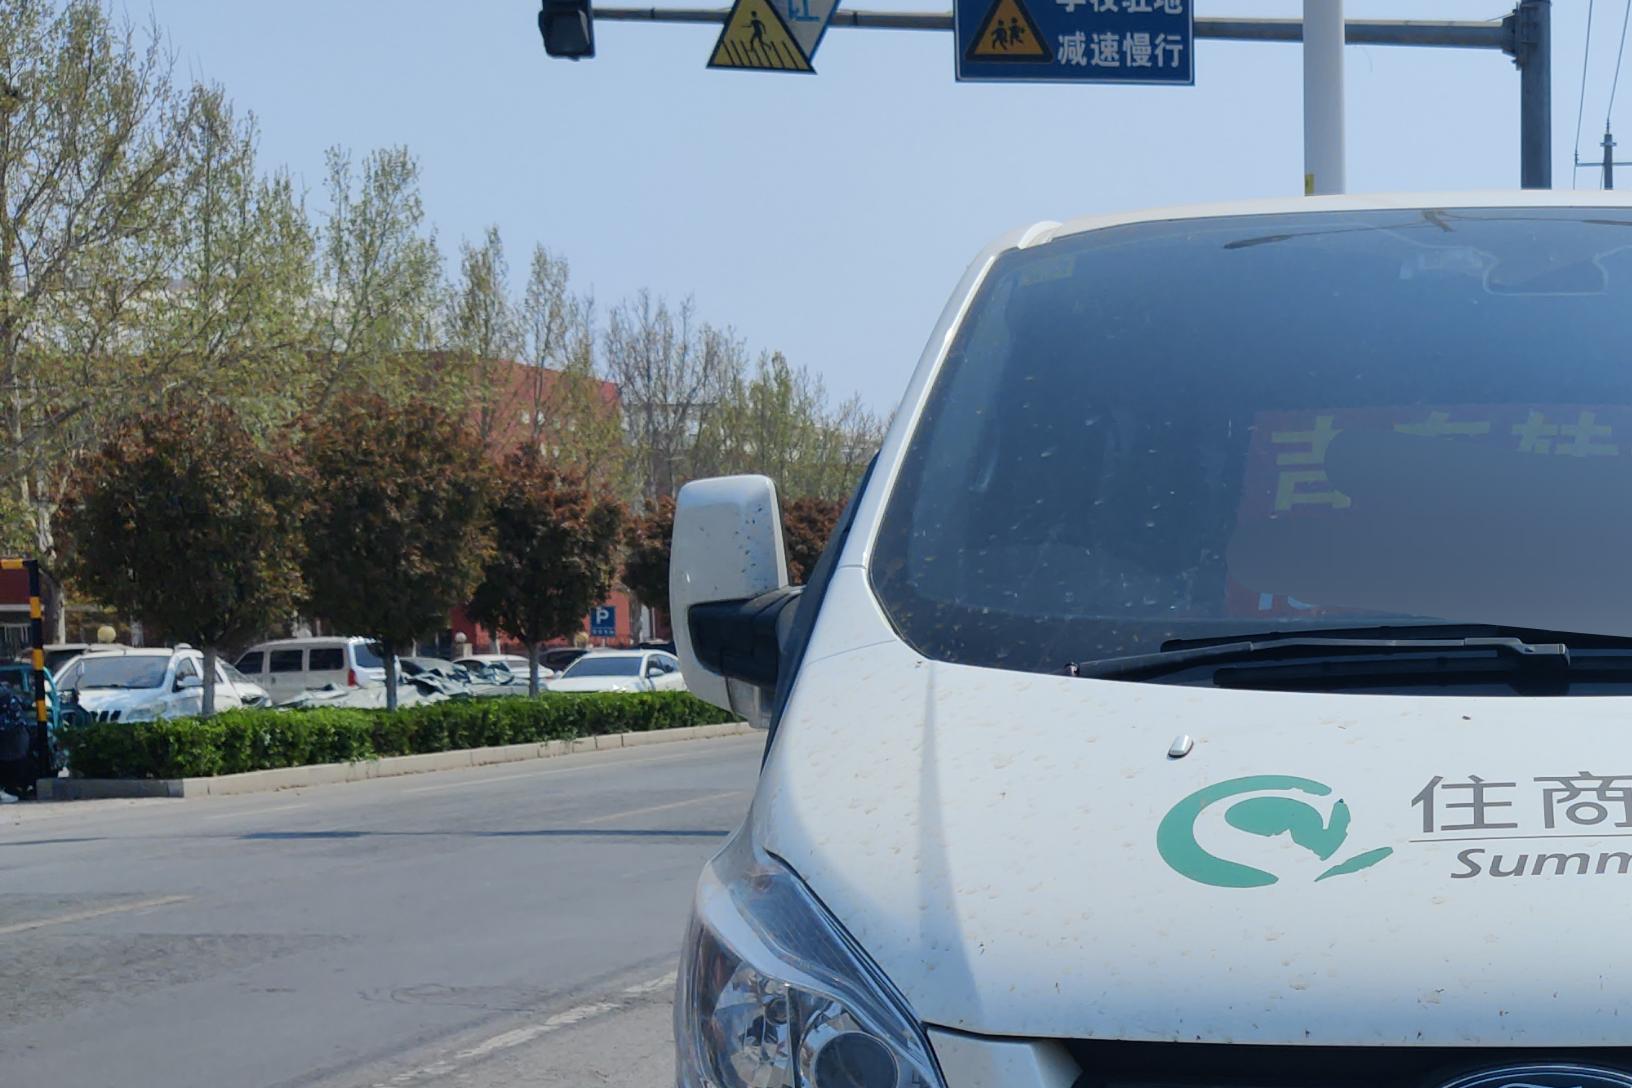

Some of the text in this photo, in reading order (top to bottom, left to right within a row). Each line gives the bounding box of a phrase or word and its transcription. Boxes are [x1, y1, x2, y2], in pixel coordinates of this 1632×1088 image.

[1057, 30, 1184, 68] 减速慢行
[596, 606, 609, 625] P
